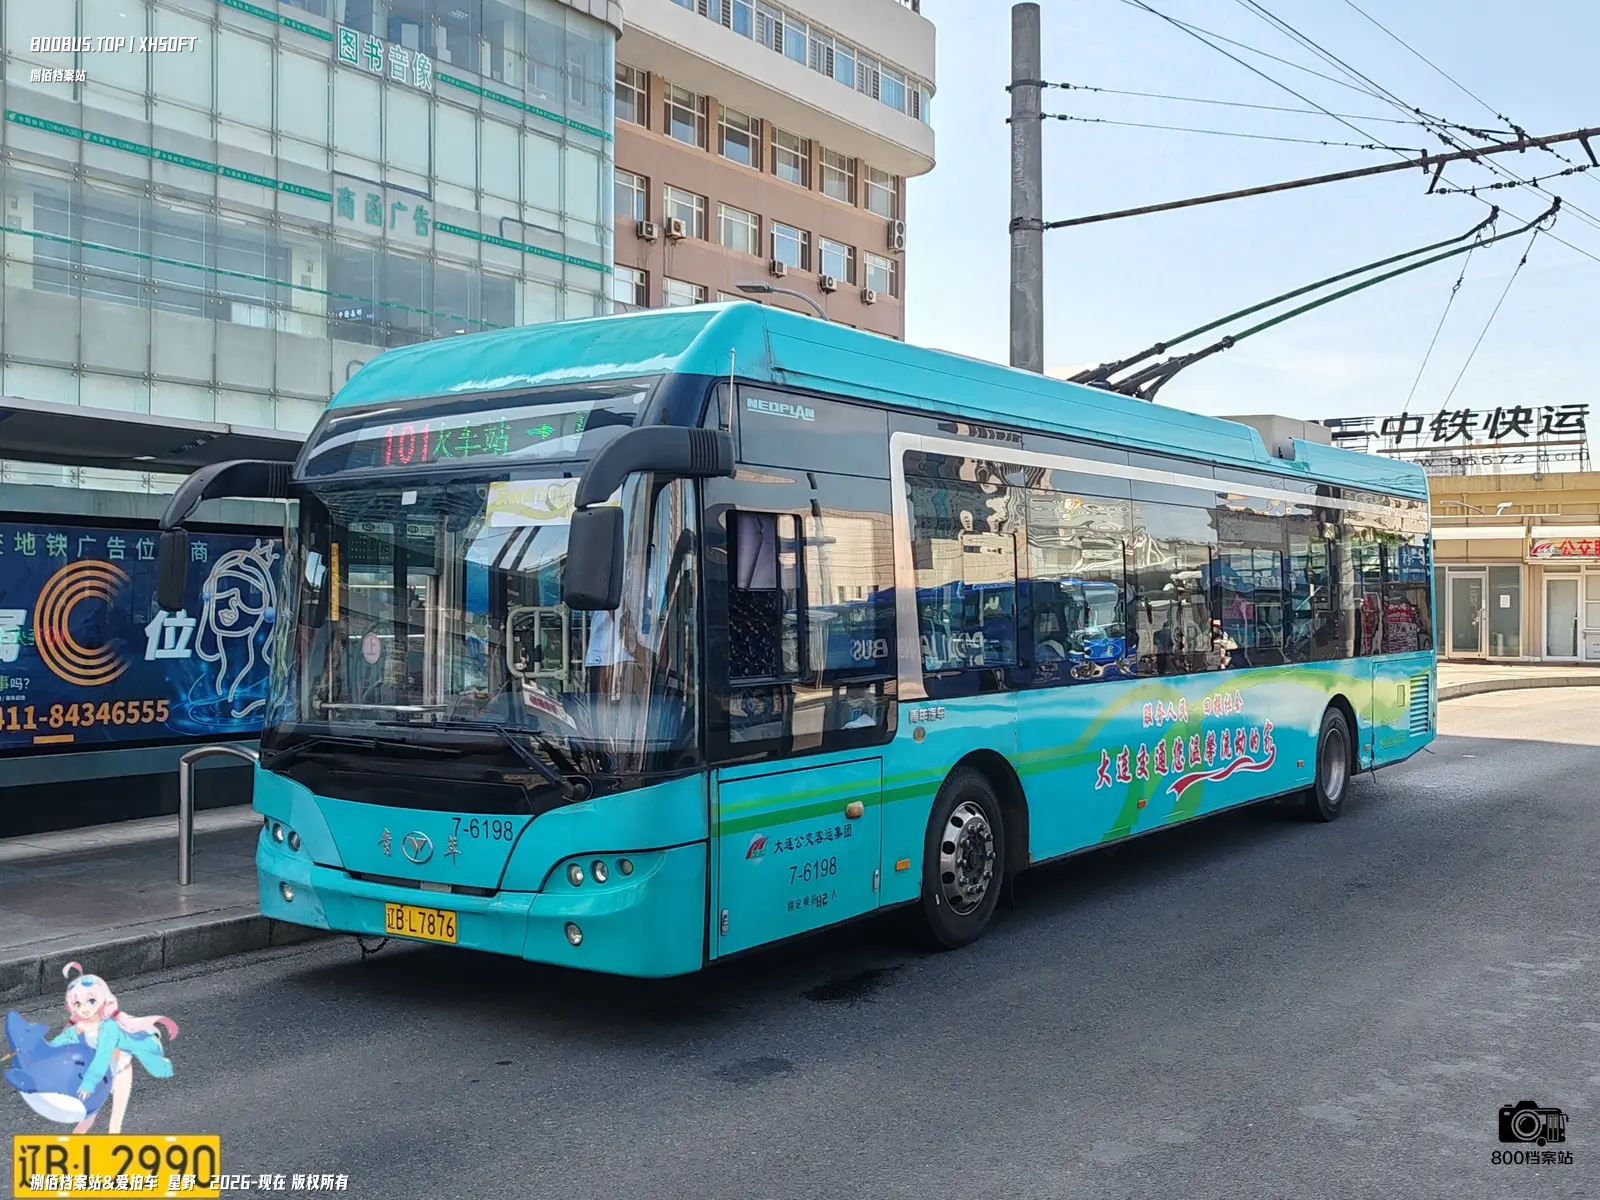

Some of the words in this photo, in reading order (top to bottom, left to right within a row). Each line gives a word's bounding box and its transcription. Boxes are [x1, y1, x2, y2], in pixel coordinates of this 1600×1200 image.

[337, 24, 432, 90] 图书音像
[337, 187, 432, 237] 商函广告
[747, 398, 815, 421] NEOPLAN
[1380, 404, 1589, 445] 中铁快运
[384, 423, 430, 465] 101
[431, 416, 513, 457] 火车站
[1450, 453, 1525, 467] 95572
[0, 531, 208, 563] 地铁广告位商
[452, 817, 513, 841] 7-6198
[773, 823, 852, 854] 大连公交客运集团
[789, 856, 837, 885] 7-6198
[387, 907, 455, 938] 辽B·L7876
